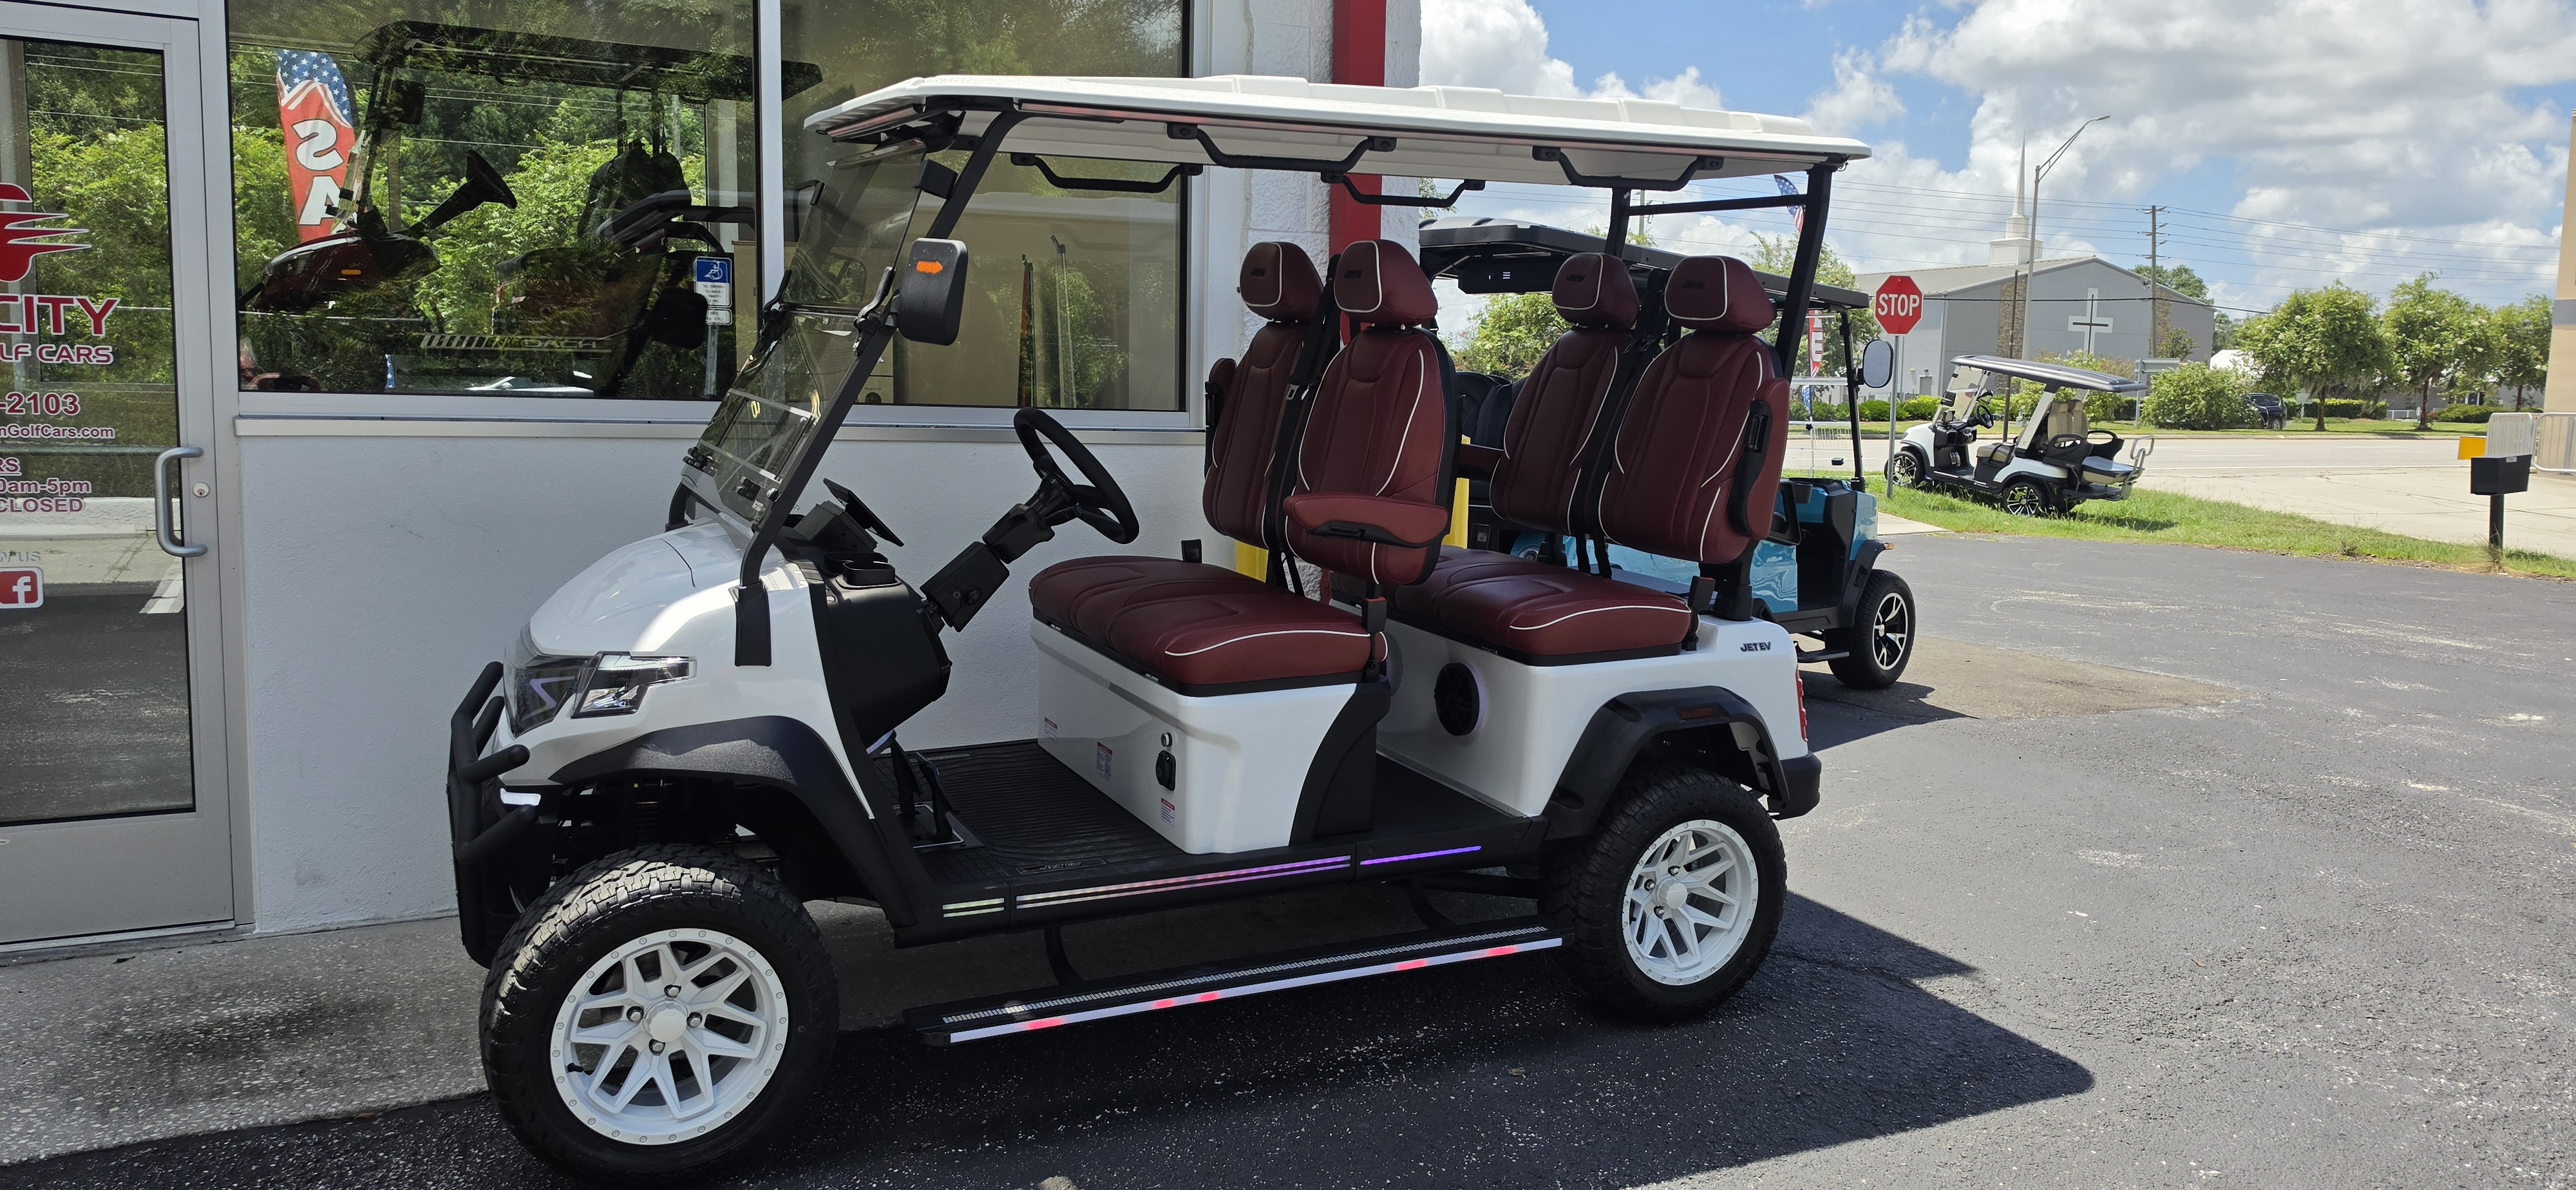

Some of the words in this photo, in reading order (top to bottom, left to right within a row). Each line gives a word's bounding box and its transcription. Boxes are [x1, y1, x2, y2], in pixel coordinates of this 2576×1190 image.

[1877, 293, 1920, 316] STOP
[37, 345, 113, 363] CARS
[0, 393, 79, 414] -2103
[0, 498, 84, 513] CLOSED
